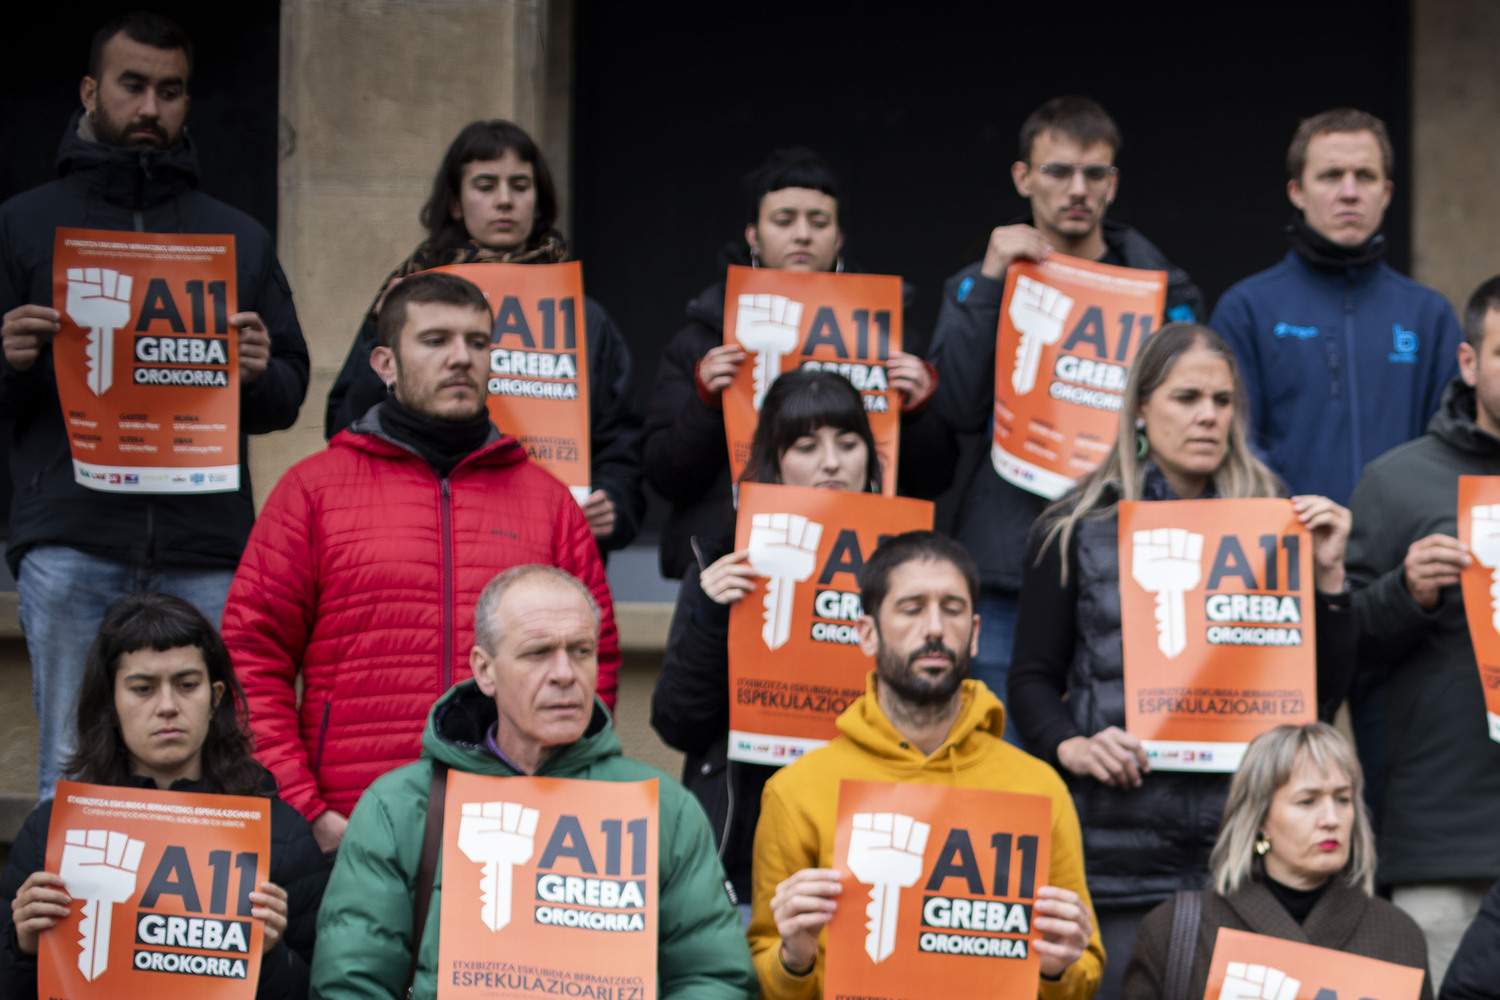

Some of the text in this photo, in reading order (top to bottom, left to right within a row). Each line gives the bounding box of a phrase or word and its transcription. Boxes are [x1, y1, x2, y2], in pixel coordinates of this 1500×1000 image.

[135, 278, 228, 334] A11
[492, 295, 576, 349] A11
[135, 337, 228, 364] GREBA
[802, 306, 890, 361] A11
[134, 368, 228, 386] OROKORRA
[490, 349, 577, 379] GREBA
[1055, 355, 1126, 391] GREB
[1206, 534, 1300, 591] A11
[1206, 594, 1301, 622] GREBA
[737, 688, 847, 714] ESPEKULAZIO
[537, 815, 648, 876] A11
[925, 828, 1038, 899] A11
[138, 845, 258, 917] A11
[536, 874, 645, 909] GREBA
[138, 914, 248, 952] GREBA
[536, 906, 645, 932] OROKORRA
[922, 896, 1030, 934] GREBA
[918, 931, 1028, 959] OROKORRA
[135, 950, 246, 978] OROKORRA
